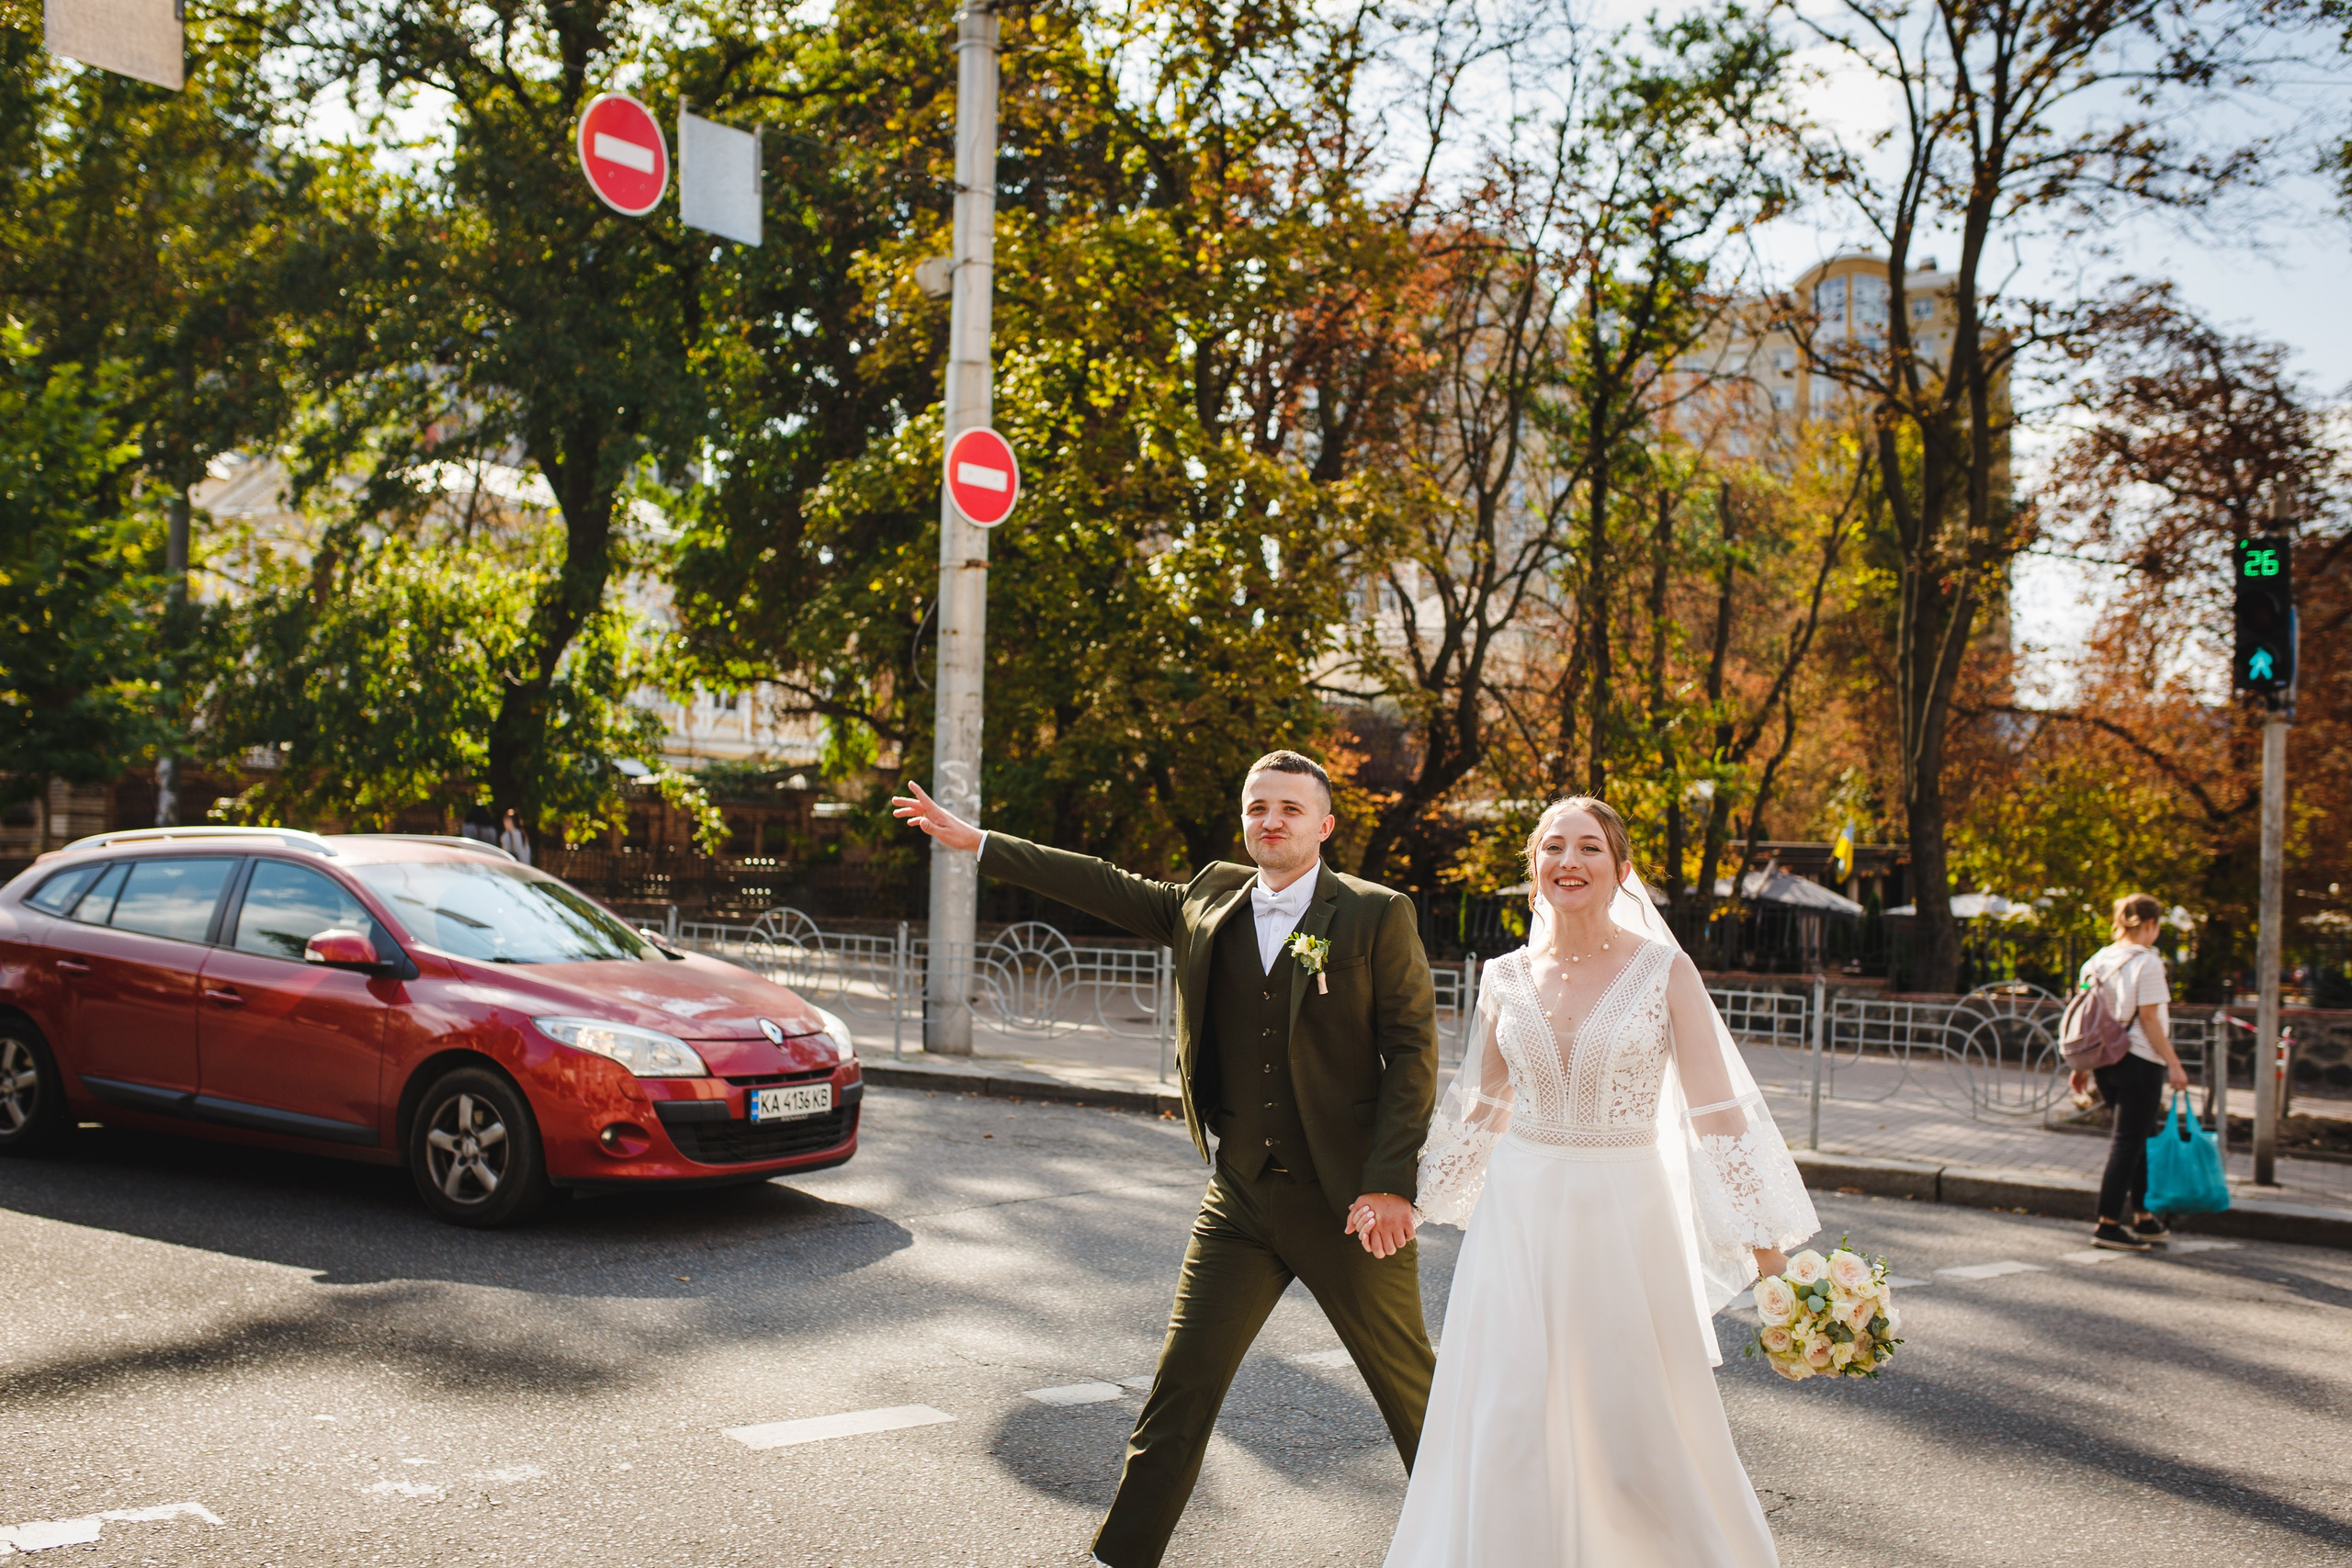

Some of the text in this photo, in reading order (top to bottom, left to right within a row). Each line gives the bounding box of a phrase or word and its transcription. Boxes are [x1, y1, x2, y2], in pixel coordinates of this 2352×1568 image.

[2244, 549, 2279, 576] 26
[761, 1089, 828, 1113] KA 4136 KB
